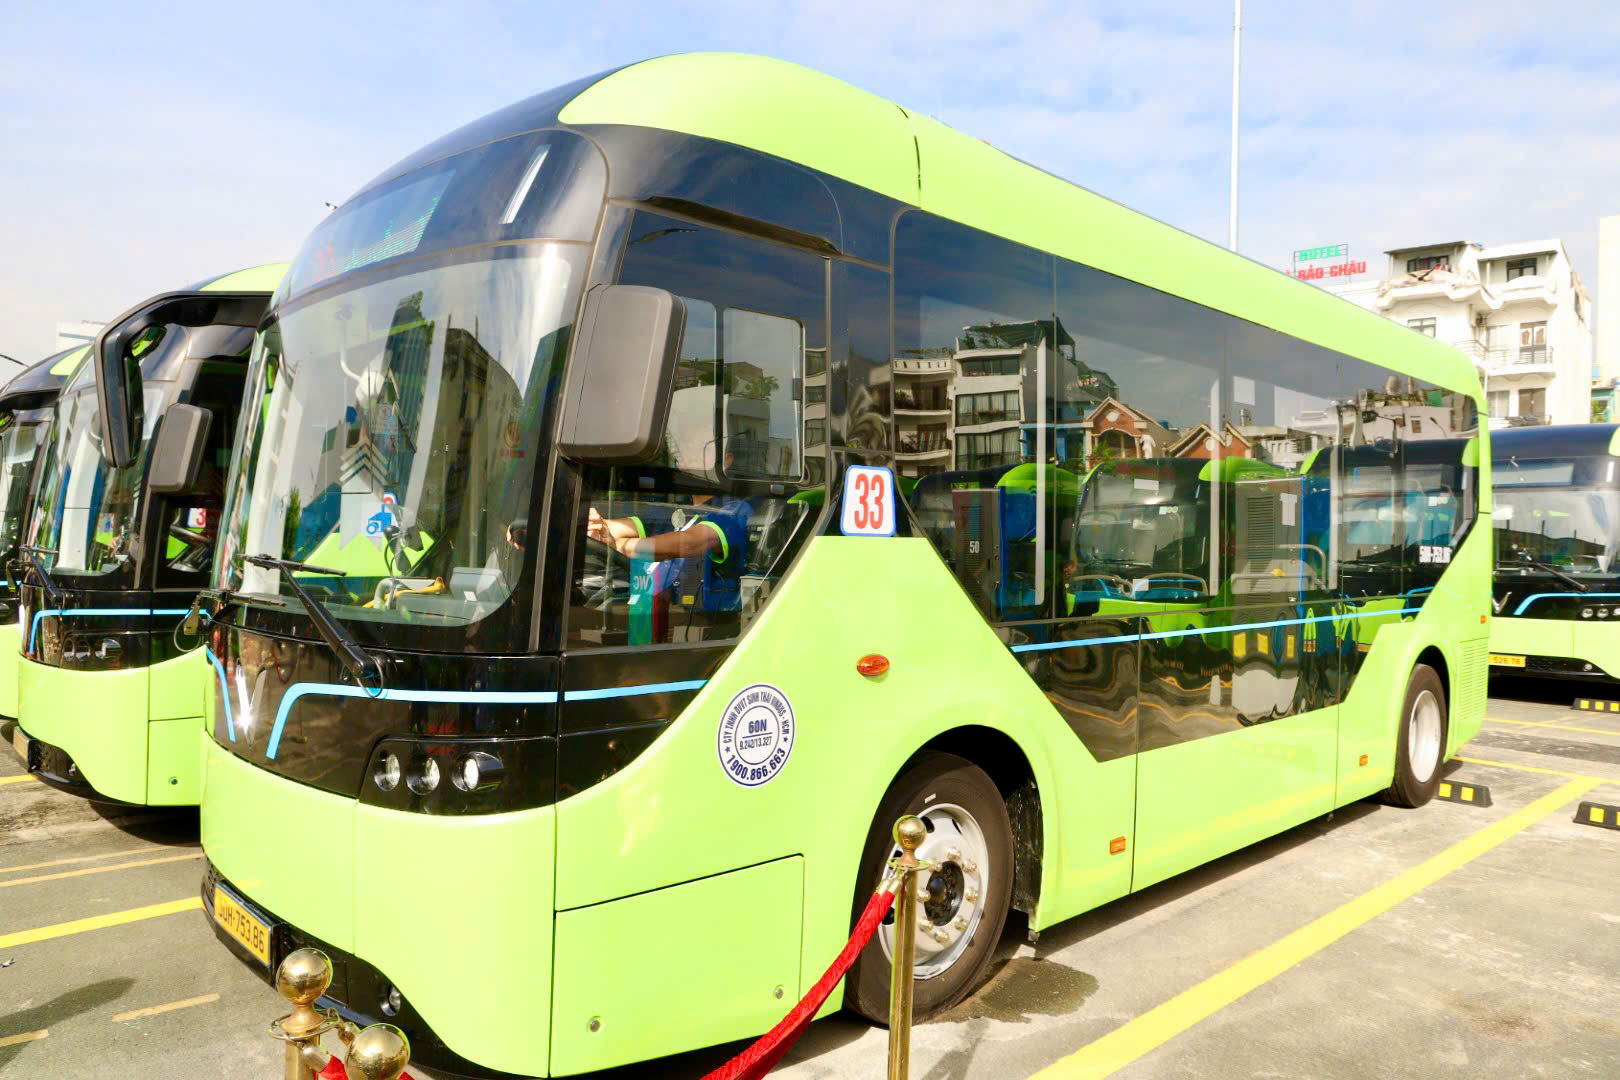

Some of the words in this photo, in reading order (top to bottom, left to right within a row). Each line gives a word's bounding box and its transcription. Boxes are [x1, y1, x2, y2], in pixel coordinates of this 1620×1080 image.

[854, 473, 885, 529] 33
[969, 540, 980, 553] 50
[748, 719, 767, 734] 60N
[726, 747, 786, 780] 1900.866.663
